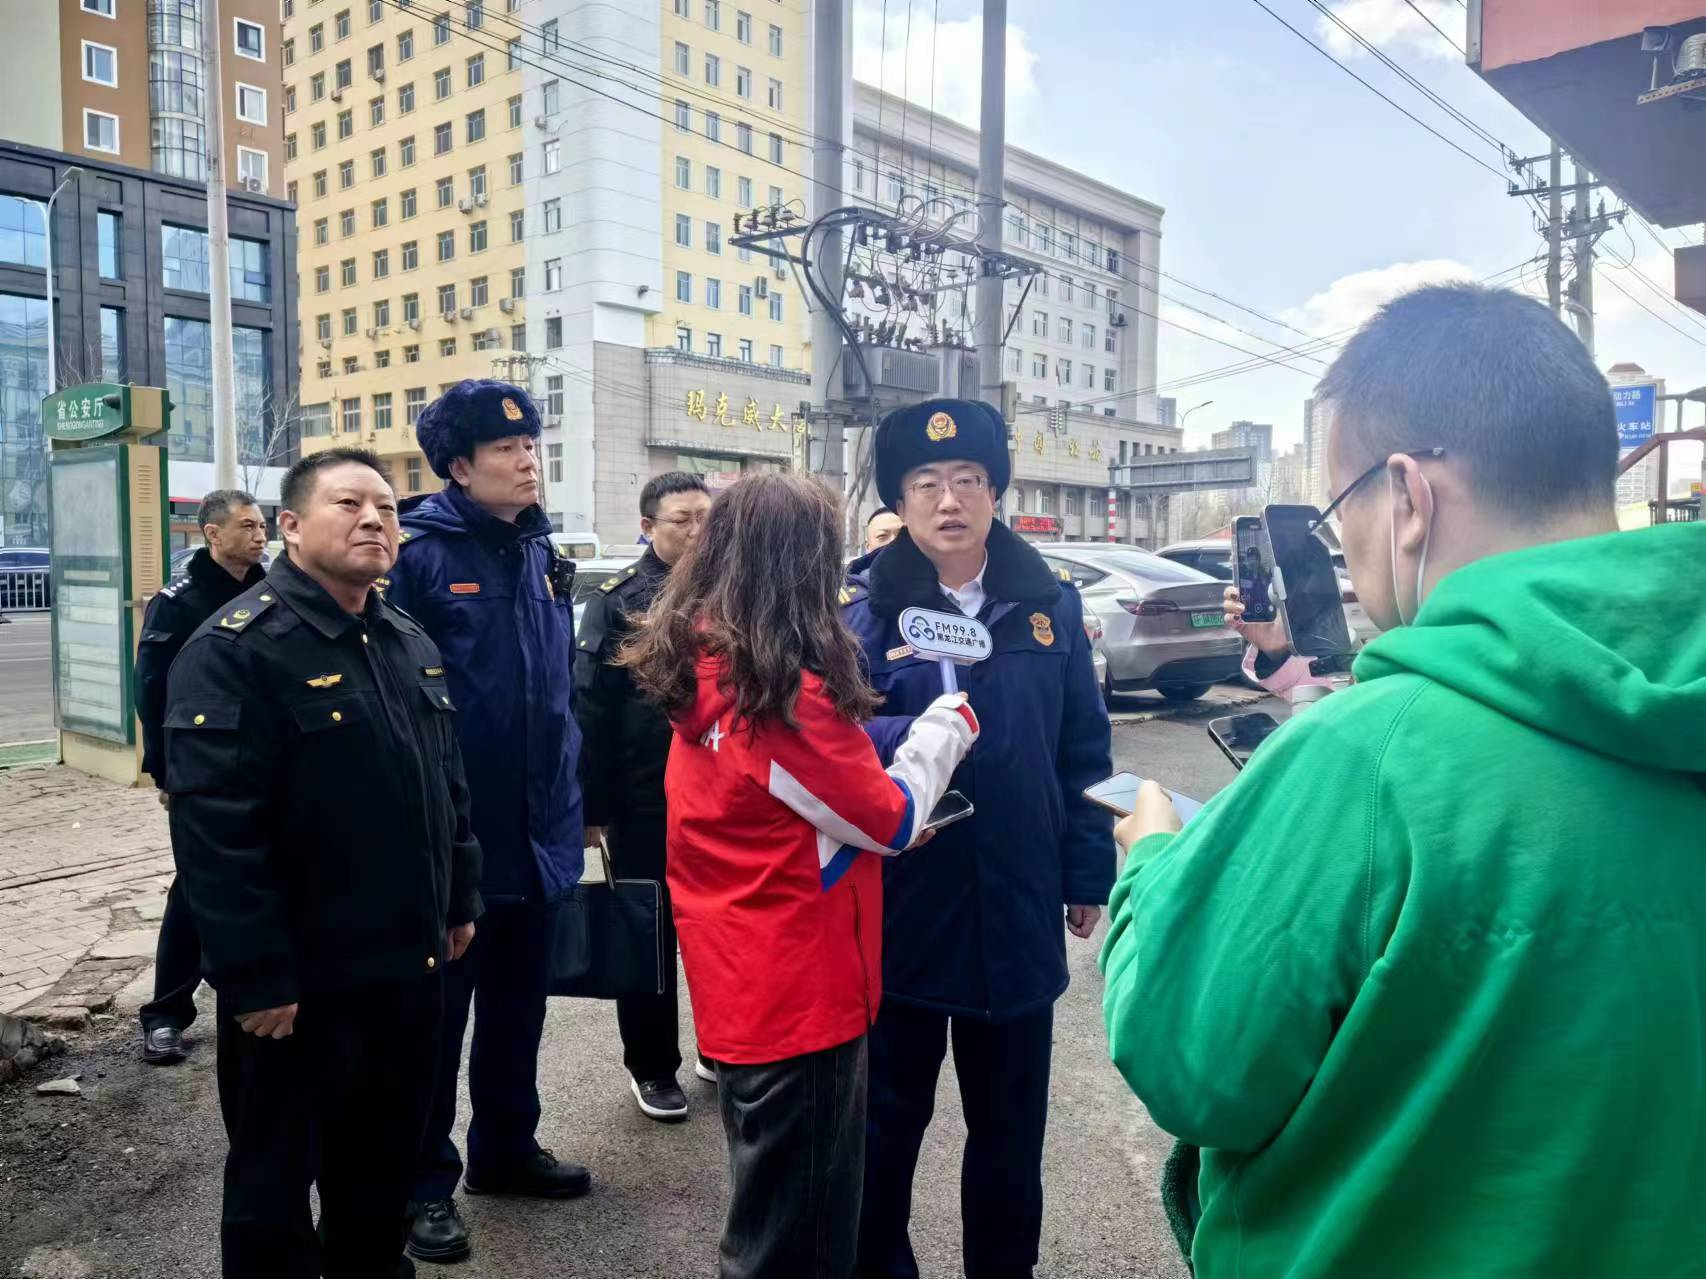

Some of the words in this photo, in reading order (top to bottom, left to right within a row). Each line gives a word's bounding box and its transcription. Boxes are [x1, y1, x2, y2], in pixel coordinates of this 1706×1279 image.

[57, 397, 104, 420] 省公安厅
[1617, 421, 1652, 431] 火车站
[935, 621, 977, 637] FM99.8
